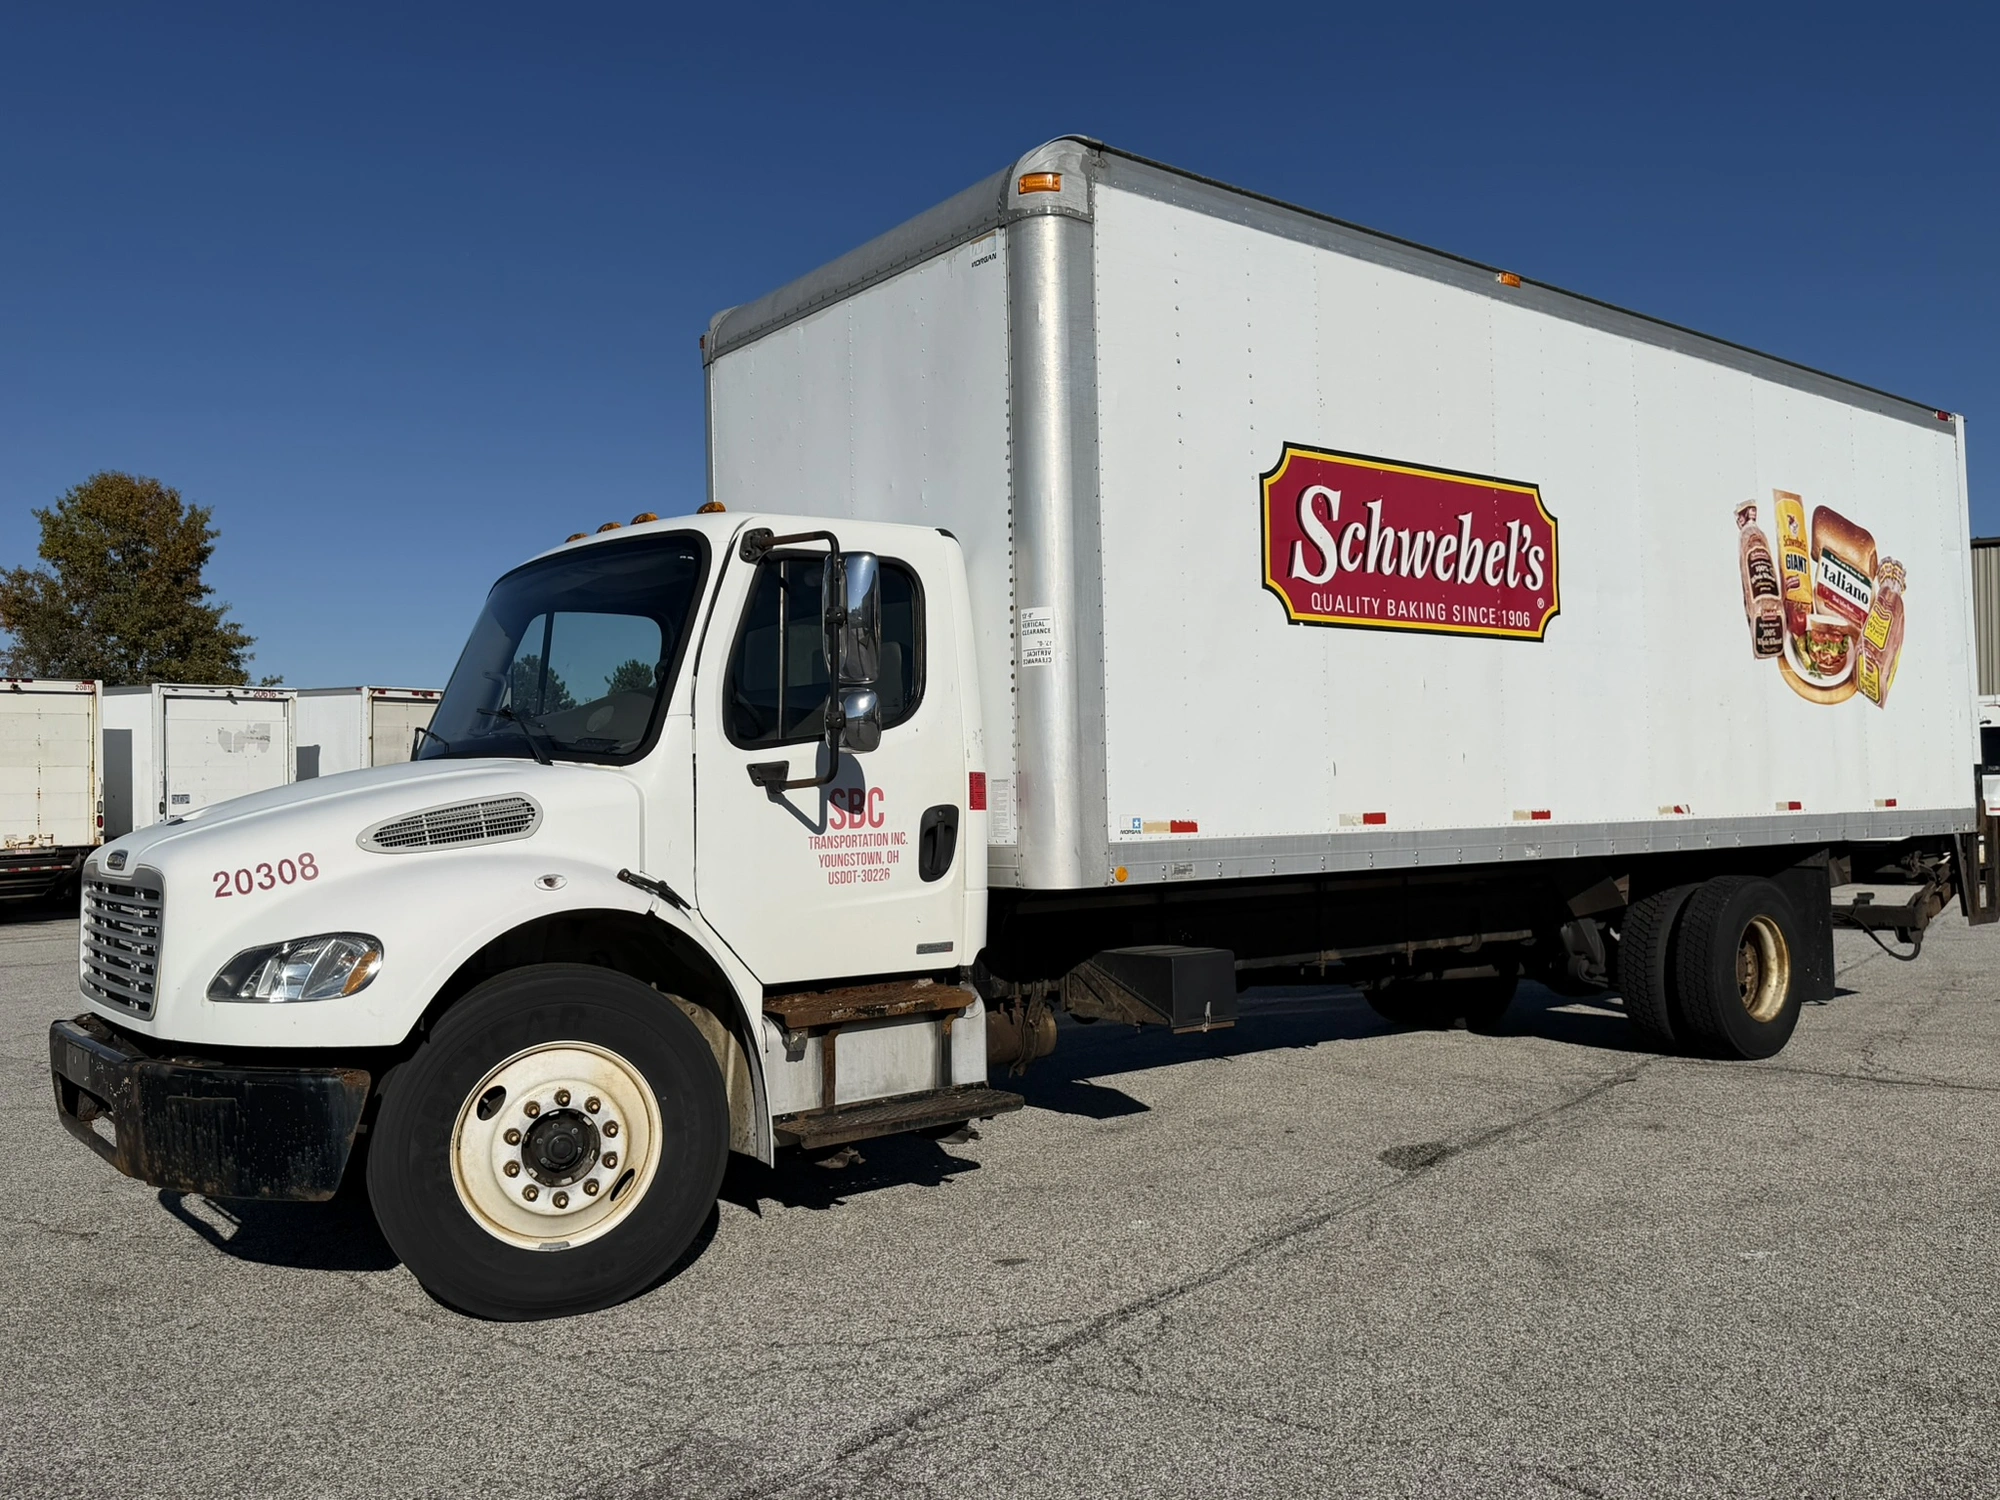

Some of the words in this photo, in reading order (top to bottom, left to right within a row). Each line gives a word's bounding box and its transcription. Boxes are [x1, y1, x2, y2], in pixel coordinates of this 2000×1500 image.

[971, 252, 997, 268] MORGAN
[1288, 484, 1545, 591] Schwebel's
[1785, 553, 1807, 574] GIANT
[1821, 562, 1869, 605] 'taliano
[1311, 592, 1380, 614] QUALITY
[1387, 599, 1446, 621] BAKING
[1452, 605, 1496, 625] SINCE
[1501, 610, 1531, 627] 1906
[1022, 621, 1045, 629] VERTICAL
[1022, 628, 1051, 636] CLEARANCE
[829, 786, 885, 830] SBC
[808, 833, 888, 850] TRANSPORTATION
[891, 831, 908, 845] INC.
[818, 851, 885, 868] YOUNGSTOWN,
[887, 850, 899, 863] OH
[213, 852, 319, 898] 20308
[828, 868, 891, 884] USDOT-30226
